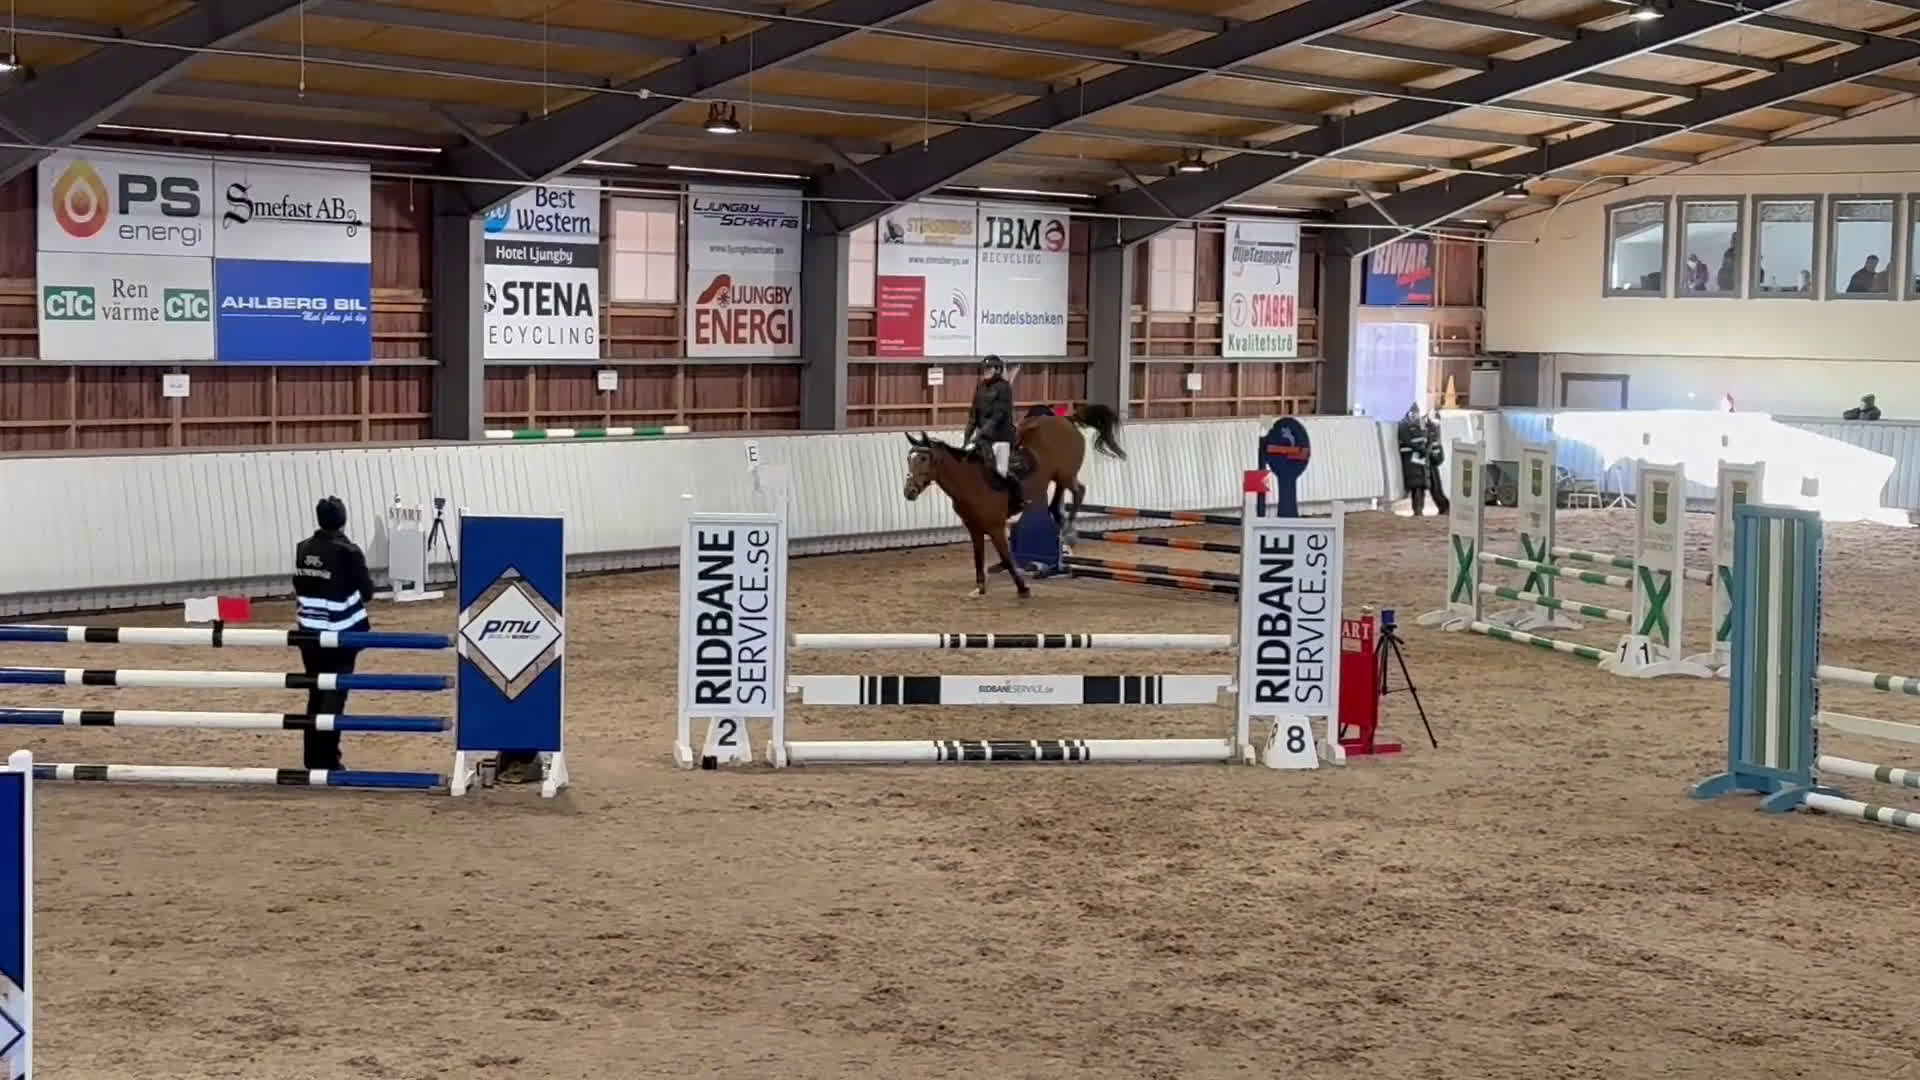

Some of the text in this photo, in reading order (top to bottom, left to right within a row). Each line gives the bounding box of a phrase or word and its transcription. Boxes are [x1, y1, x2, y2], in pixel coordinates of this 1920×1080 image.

[118, 173, 201, 218] PS
[223, 181, 346, 231] Smefast AB
[536, 186, 576, 209] Best
[517, 209, 592, 234] Western
[780, 219, 799, 229] AB
[983, 216, 1042, 250] JBM
[119, 223, 202, 247] energi
[496, 246, 573, 265] Hotel Ljungby
[982, 252, 1042, 265] RECYCLING
[112, 278, 148, 298] Ren
[502, 281, 594, 317] STENA
[731, 287, 793, 305] LJUNGBY
[102, 303, 159, 321] värme
[221, 296, 367, 311] AHLBERG BIL
[1251, 294, 1294, 327] STABEN
[695, 309, 794, 345] ENERGI
[929, 309, 958, 329] SAC
[981, 310, 1064, 325] Handelsbanken
[489, 325, 595, 345] ECYCLING
[748, 446, 758, 462] E
[389, 508, 422, 521] START
[695, 530, 735, 704] RIDBANE
[737, 530, 770, 705] SERVICE.se
[1255, 534, 1295, 704] RIDBANE
[1295, 533, 1328, 703] SERVICE.se
[478, 620, 541, 641] pmu
[1342, 621, 1372, 640] ART
[717, 718, 738, 746] 2
[1286, 725, 1306, 754] 8
